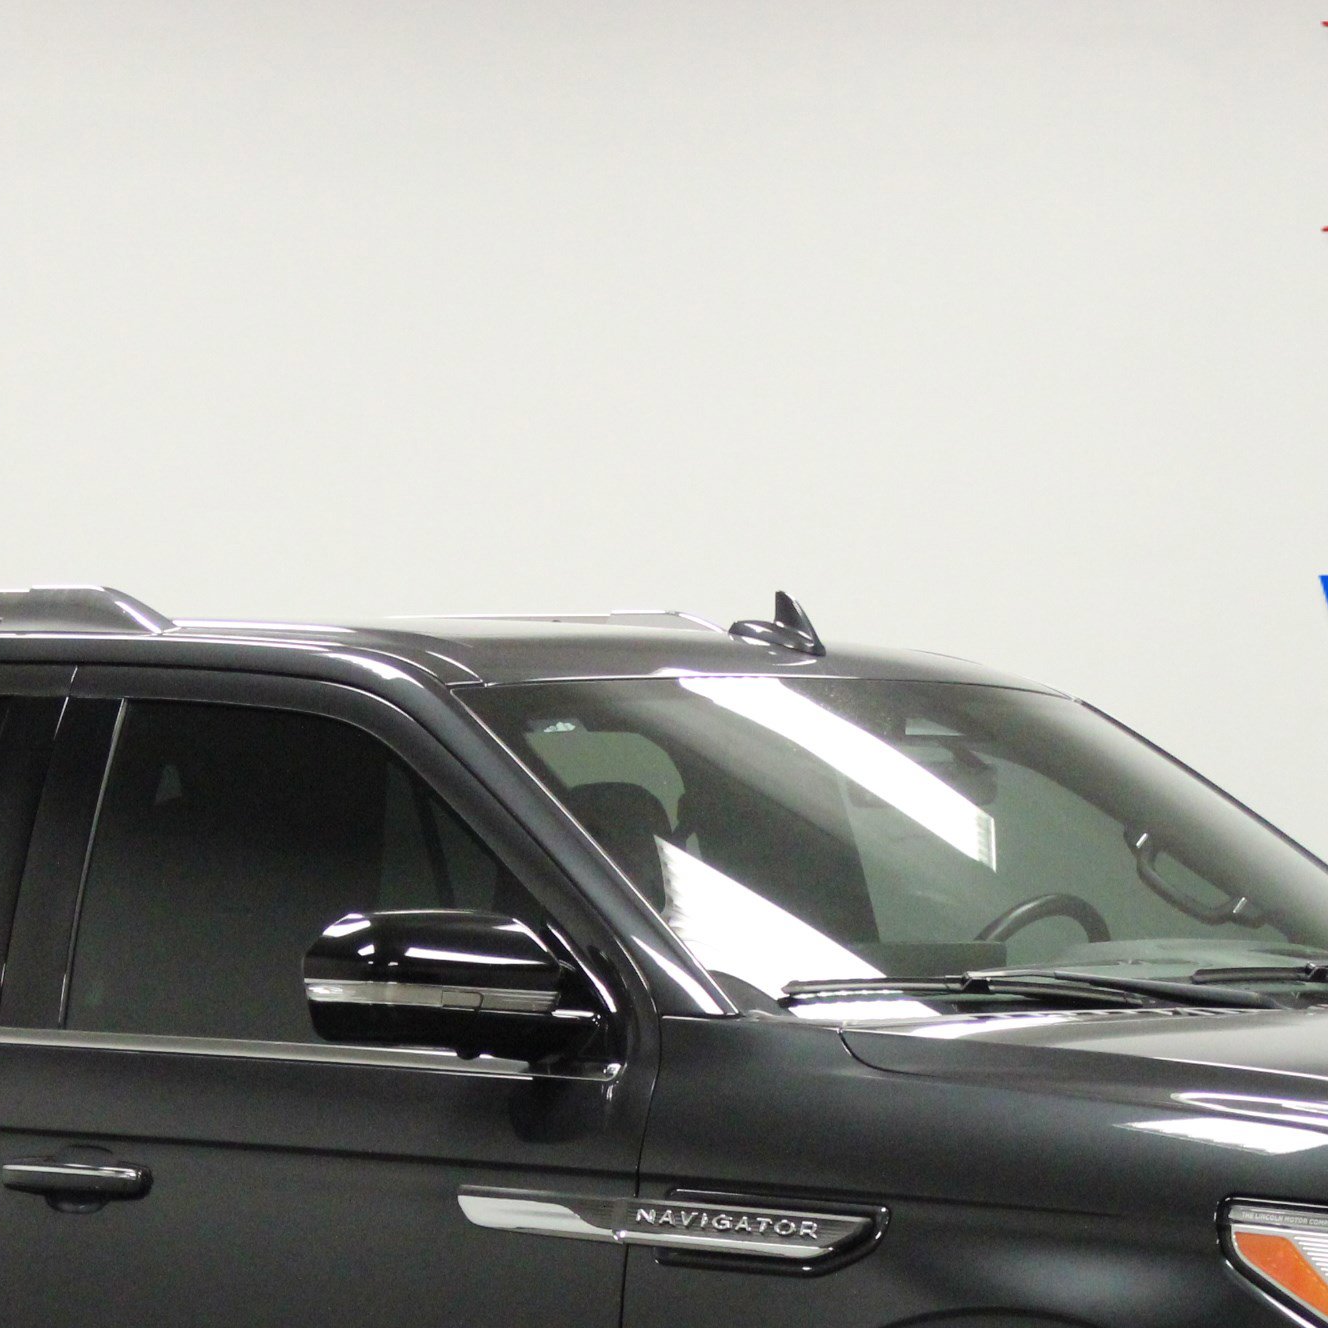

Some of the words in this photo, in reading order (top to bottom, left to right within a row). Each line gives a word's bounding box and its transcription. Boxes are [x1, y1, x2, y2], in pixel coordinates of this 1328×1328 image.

[635, 1208, 818, 1240] NAVIGATOR
[1255, 1212, 1283, 1222] LINCOLN
[1284, 1215, 1308, 1224] MOTOR
